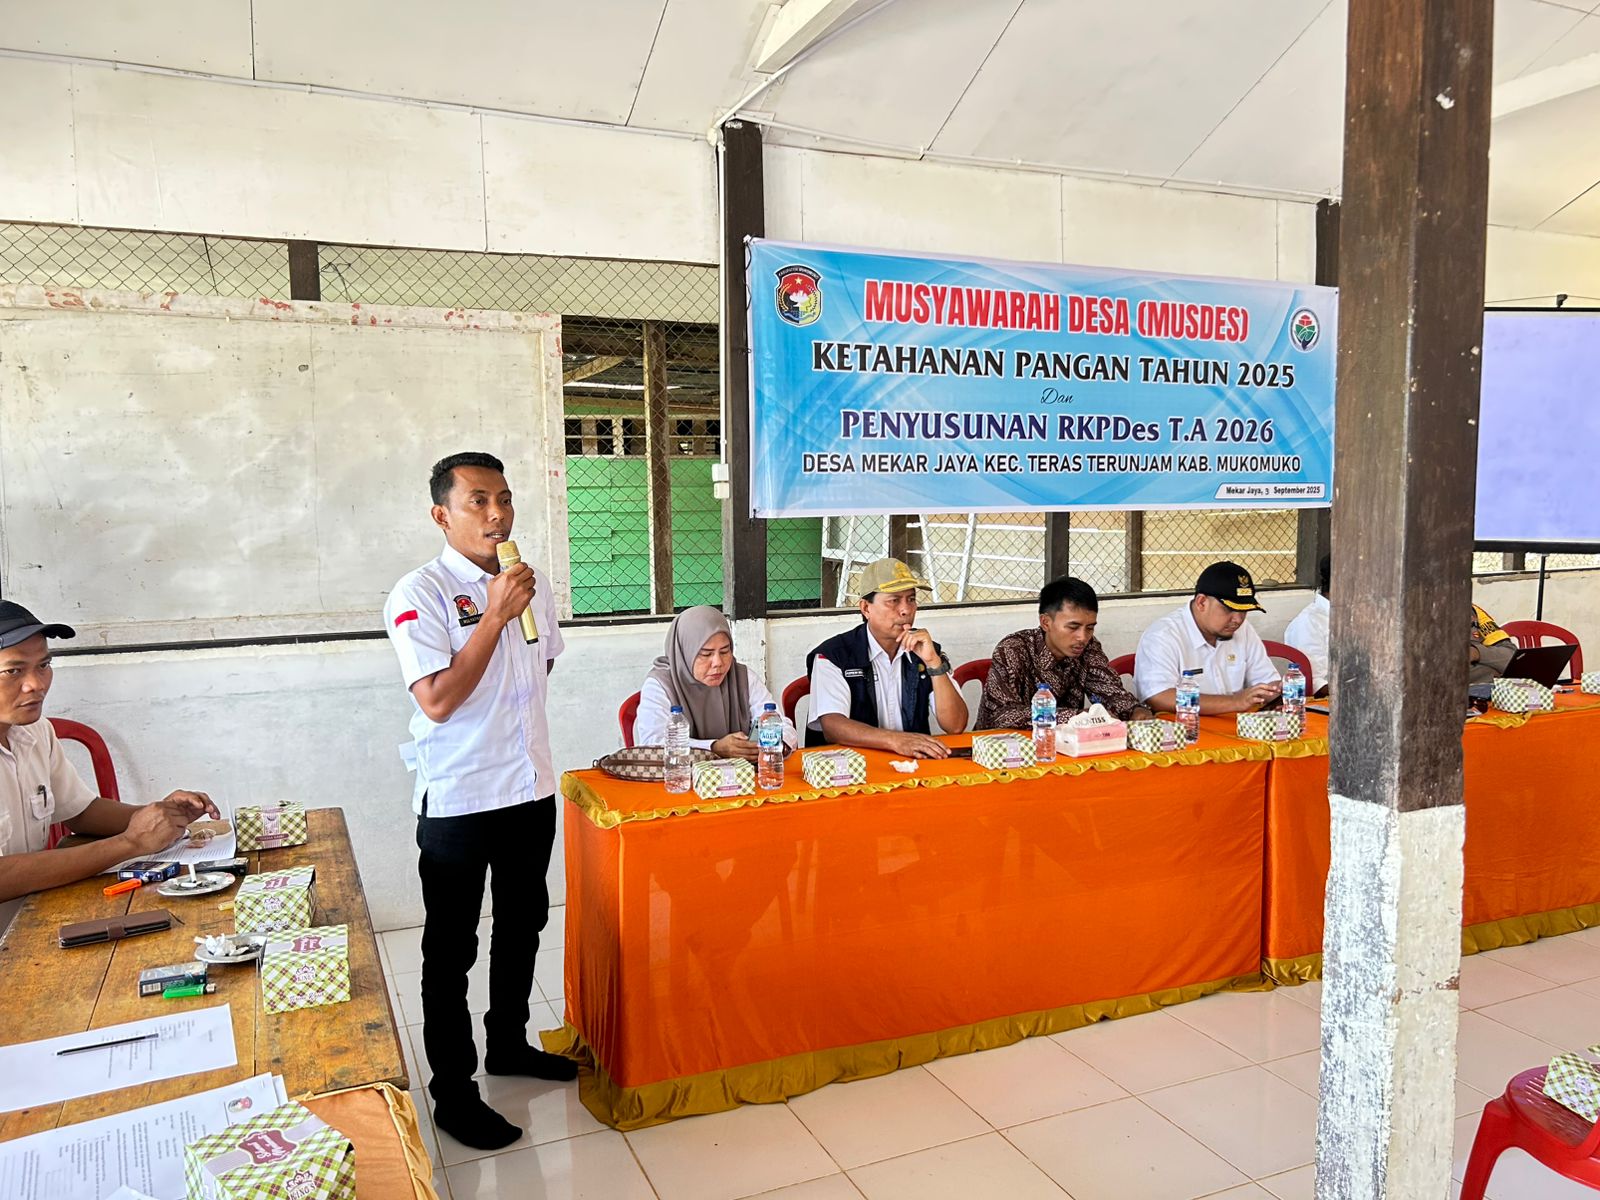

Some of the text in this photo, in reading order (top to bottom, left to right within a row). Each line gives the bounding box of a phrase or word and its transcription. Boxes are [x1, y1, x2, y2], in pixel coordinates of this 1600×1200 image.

[865, 281, 1249, 342] MUSYAWARAH DESA (MUSDES)
[813, 342, 1295, 388] KETAHANAN PANGAN TAHUN 2025
[1041, 388, 1074, 404] Dan
[842, 411, 1274, 443] PENYUSUNAN RKPDes T.A 2026
[803, 454, 1301, 473] DESA MEKAR JAYA KEC. TERAS TERUNJAM KAB. MUKOMUKO
[1226, 486, 1246, 494] Mekar
[1247, 486, 1264, 496] Jaya,
[1273, 486, 1306, 496] September
[1306, 486, 1321, 494] 2025
